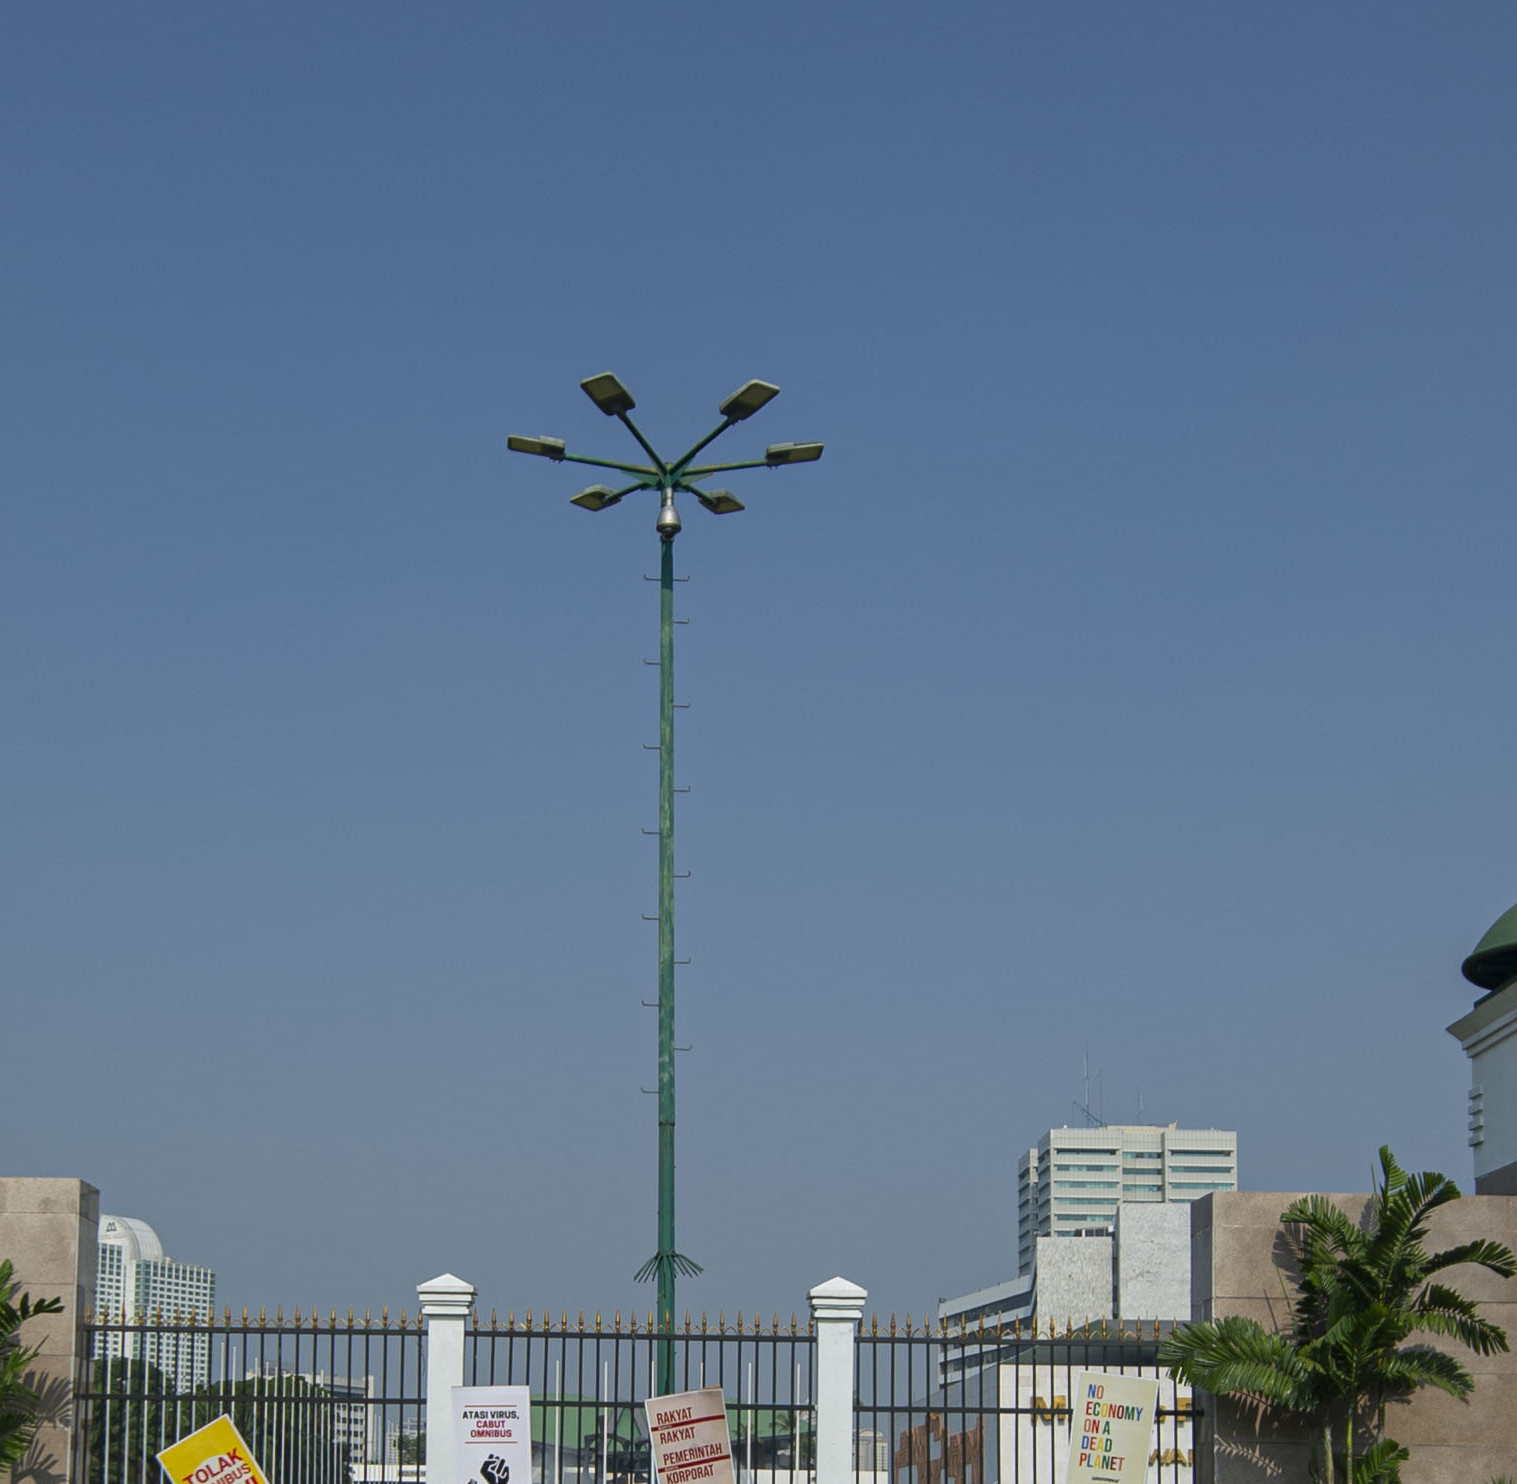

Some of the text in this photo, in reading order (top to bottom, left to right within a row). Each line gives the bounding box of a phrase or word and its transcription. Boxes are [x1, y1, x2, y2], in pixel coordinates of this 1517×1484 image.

[1088, 1384, 1104, 1399] NO
[462, 1410, 520, 1420] ATASI VIRUS,
[656, 1407, 693, 1425] RAKYAT
[1086, 1401, 1144, 1421] ECONOMY
[476, 1420, 506, 1428] CABUT
[1084, 1419, 1111, 1435] ON A
[470, 1429, 512, 1438] OMNIBUS
[659, 1427, 695, 1445] RAKYAT
[1081, 1436, 1113, 1452] DEAD
[663, 1443, 723, 1465] PEMERINTAH
[1079, 1453, 1125, 1471] PLANET
